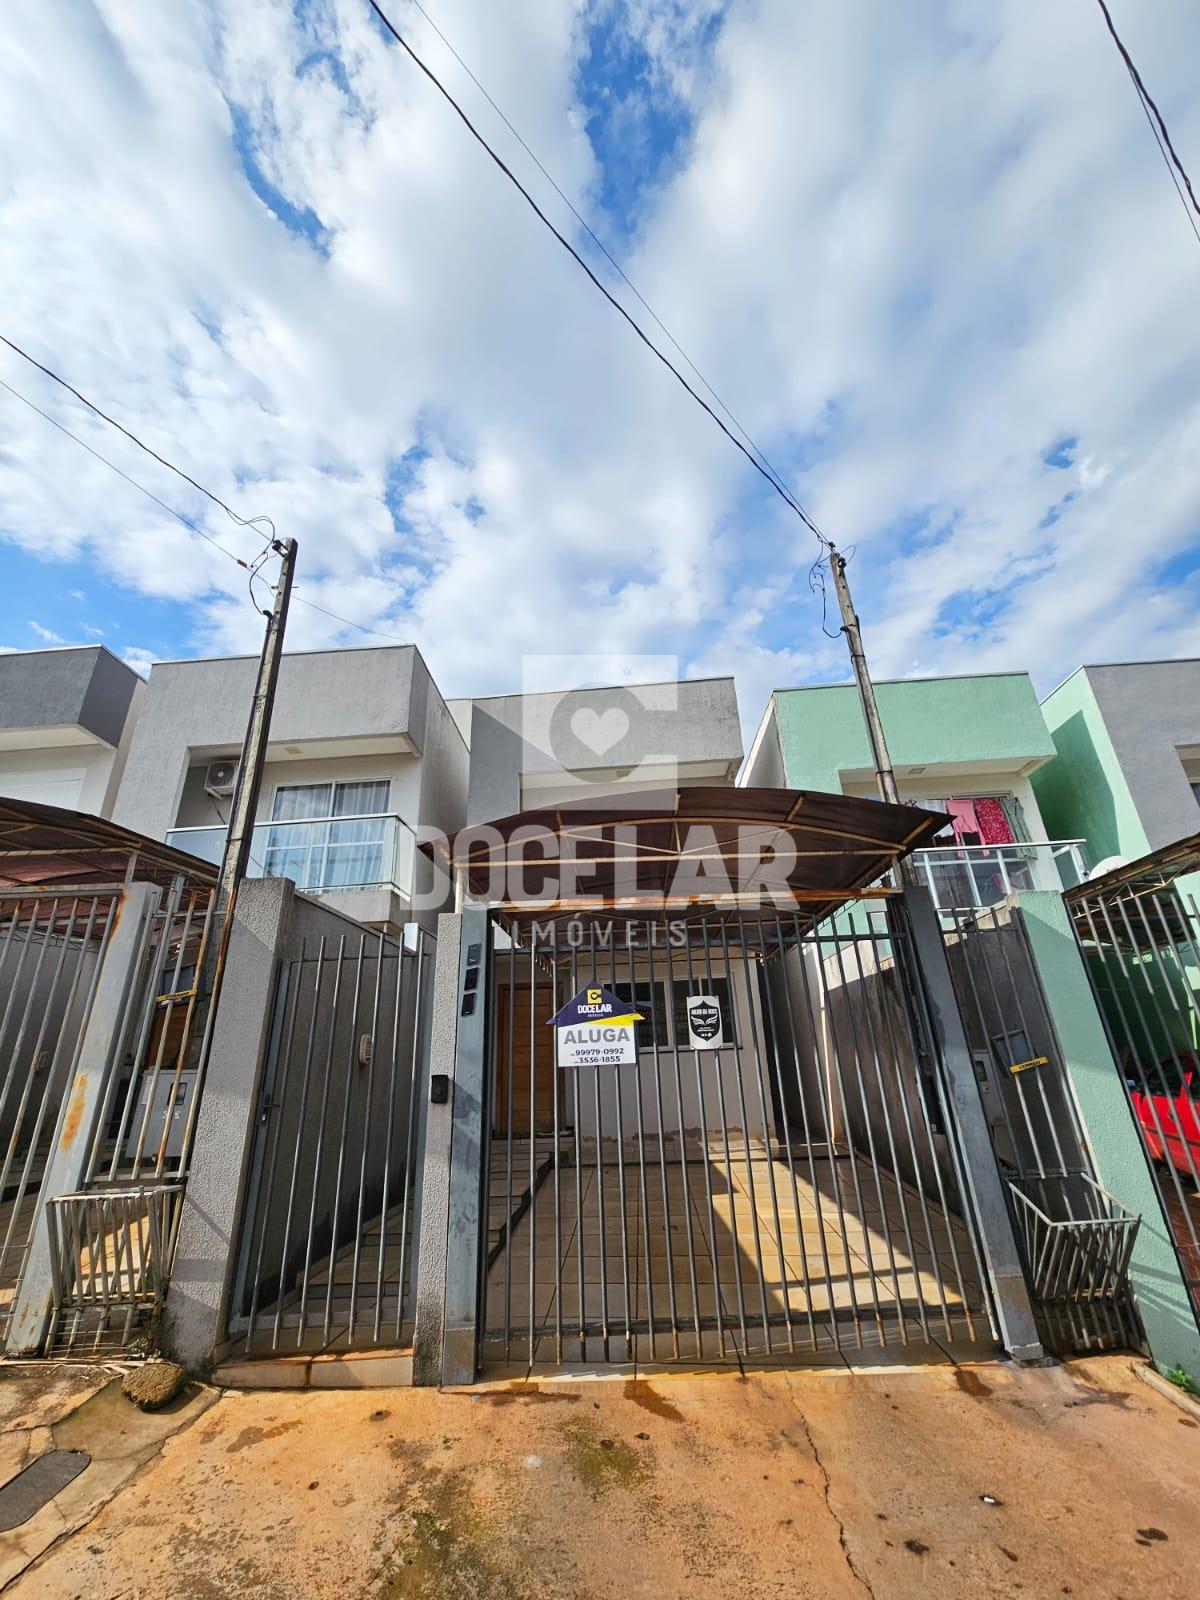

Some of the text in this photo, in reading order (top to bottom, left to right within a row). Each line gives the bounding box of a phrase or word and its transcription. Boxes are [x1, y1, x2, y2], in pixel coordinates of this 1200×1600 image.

[564, 1028, 630, 1044] ALUGA
[575, 1048, 624, 1056] 99979-0992
[579, 1056, 620, 1064] 3536-1855
